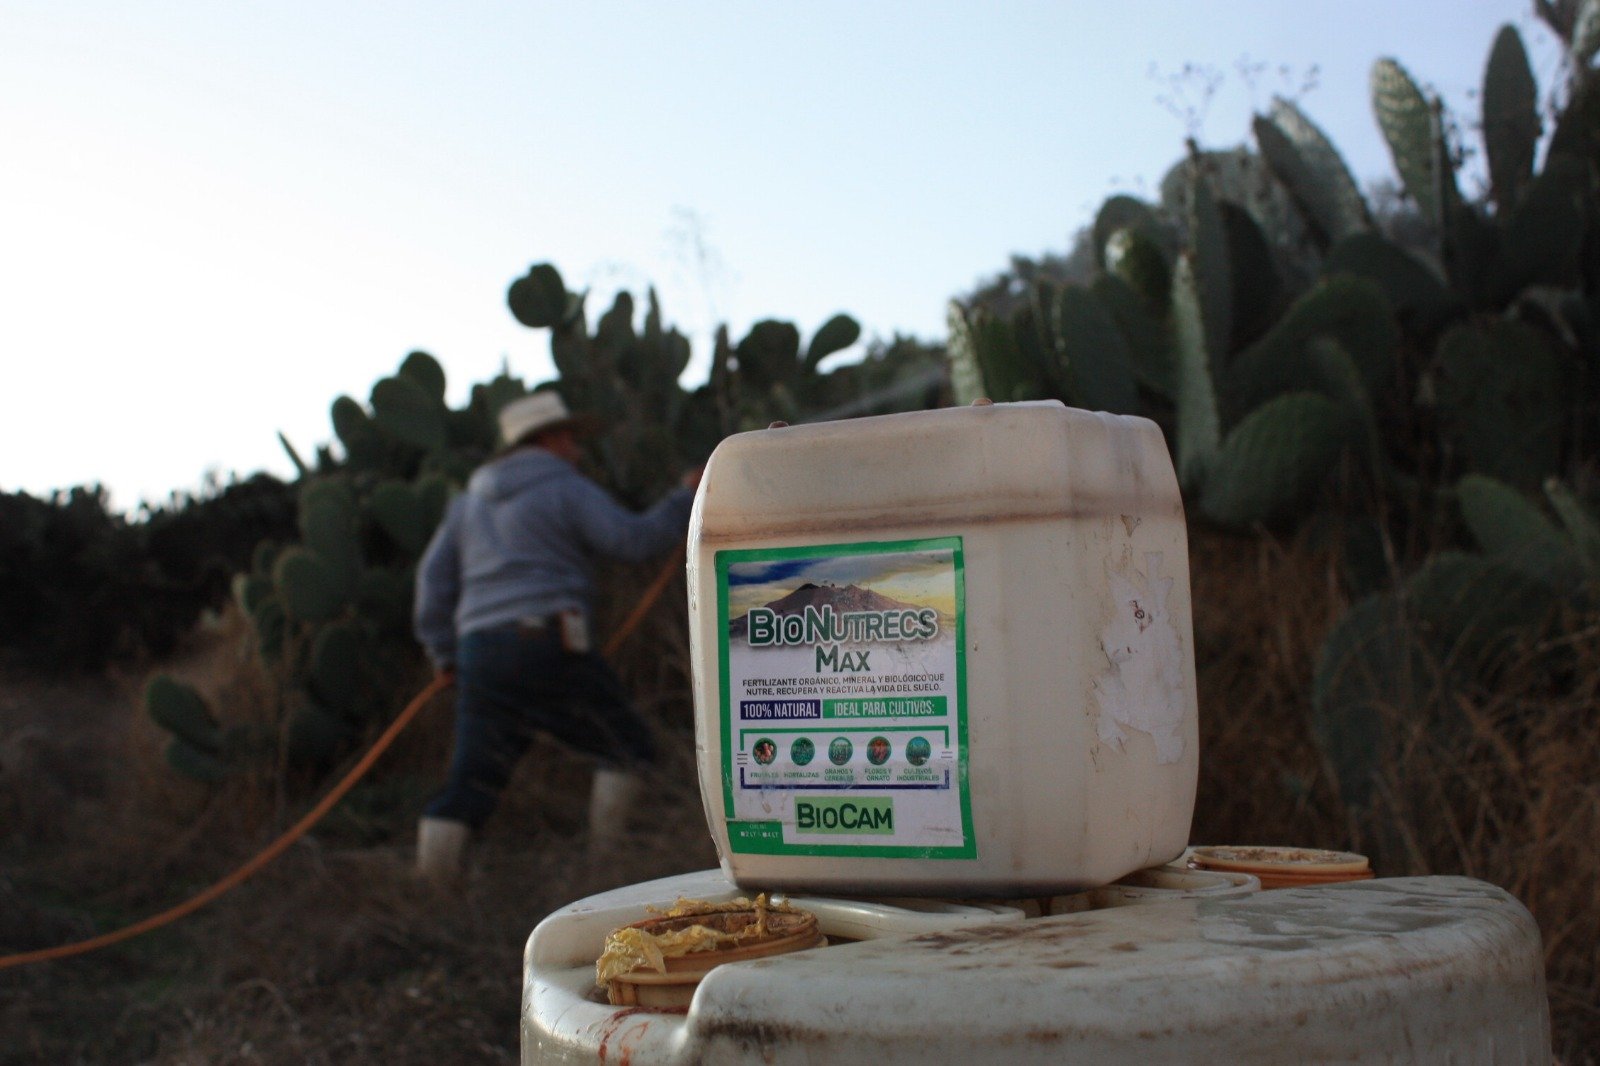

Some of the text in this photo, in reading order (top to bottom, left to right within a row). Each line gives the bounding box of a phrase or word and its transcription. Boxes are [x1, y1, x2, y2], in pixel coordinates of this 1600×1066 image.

[816, 645, 870, 673] MAX
[742, 678, 797, 687] FERTILIZANTE
[843, 676, 876, 684] MINERAL
[878, 675, 883, 683] Y
[885, 673, 927, 683] BIOLÓGICO
[928, 673, 945, 682] QUE
[746, 687, 775, 696] NUTRE,
[776, 687, 818, 695] RECUPERA
[826, 685, 864, 694] REACTIVA
[876, 684, 895, 692] VIDA
[896, 683, 912, 692] DEL
[913, 683, 941, 691] SUELO.
[744, 702, 818, 718] 100% NATURAL
[834, 700, 935, 716] IDEAL PARA CULTIVOS:
